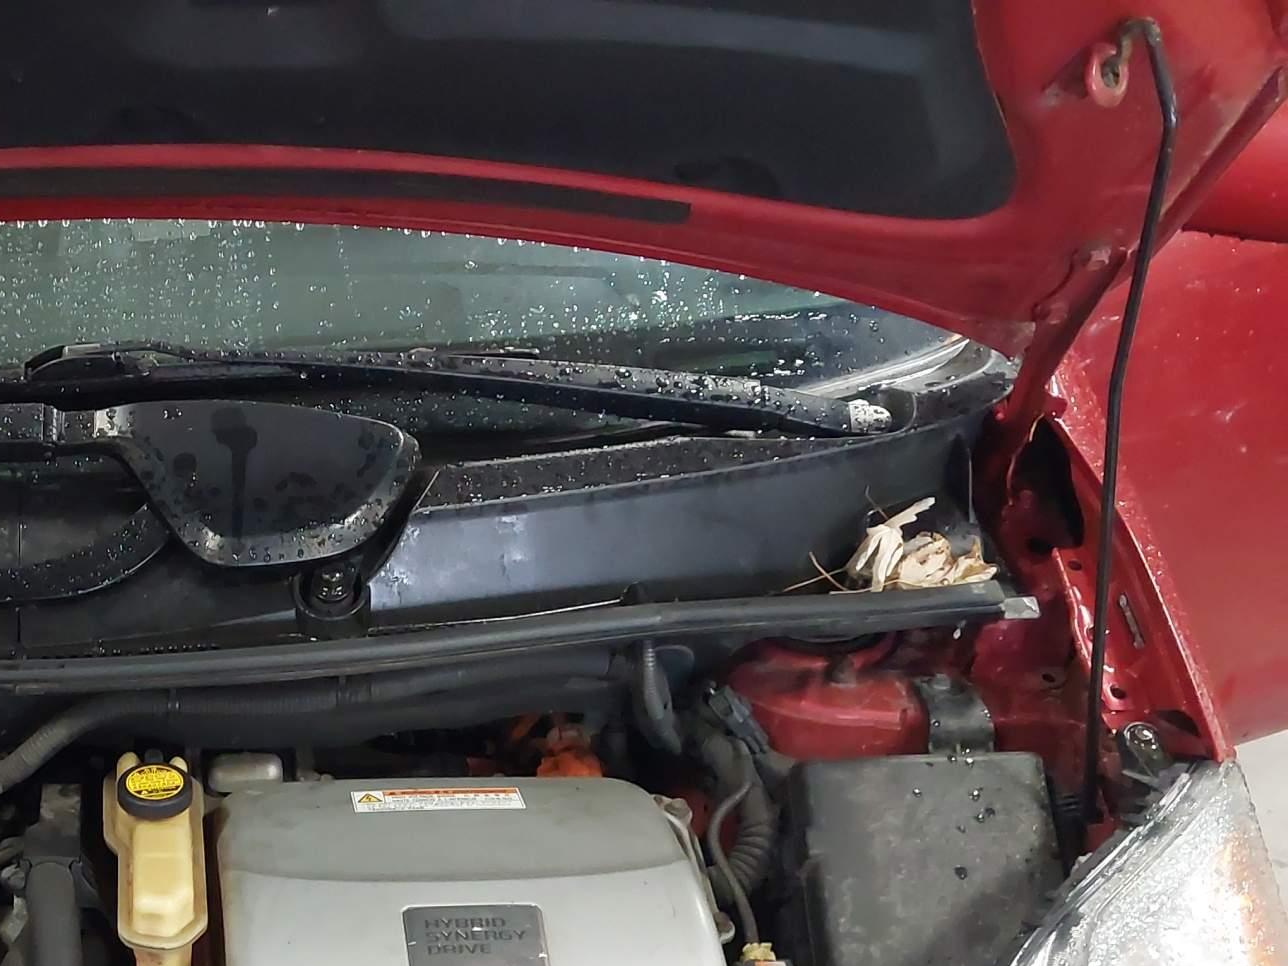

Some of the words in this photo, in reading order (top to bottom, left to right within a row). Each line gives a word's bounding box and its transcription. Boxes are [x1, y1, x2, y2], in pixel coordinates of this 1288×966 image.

[424, 917, 506, 929] HYBRID
[425, 929, 527, 943] SYNERGY
[427, 943, 492, 955] DRIVE
